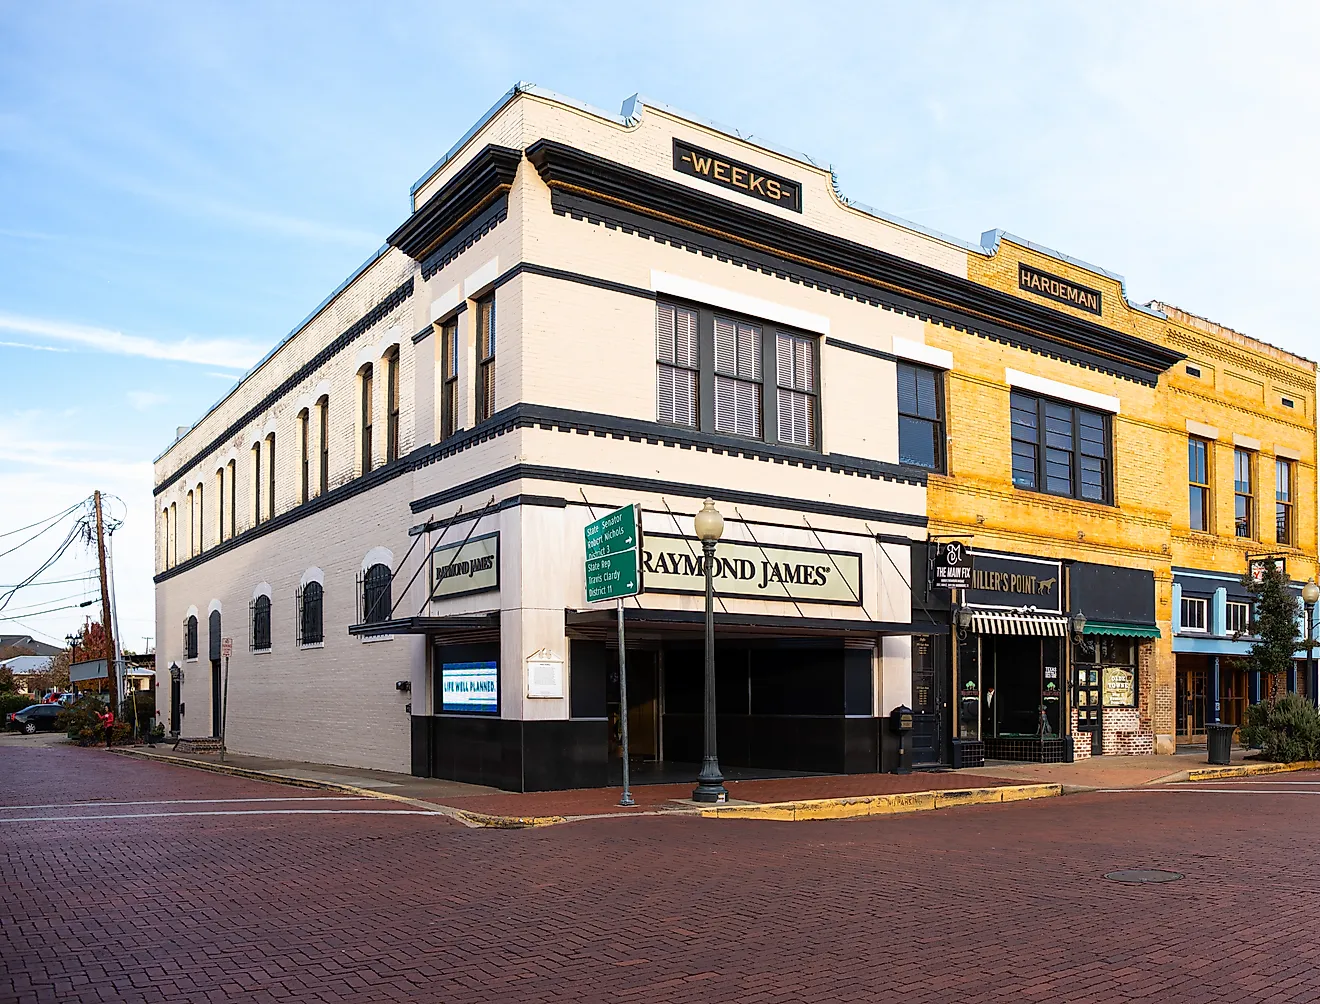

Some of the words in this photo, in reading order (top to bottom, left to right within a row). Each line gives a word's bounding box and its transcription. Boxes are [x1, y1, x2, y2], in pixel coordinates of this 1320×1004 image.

[1021, 270, 1097, 309] HARDEMAN
[587, 525, 599, 536] State
[601, 514, 622, 529] Senator
[587, 536, 604, 549] Robert
[604, 526, 625, 541] Nichols
[588, 547, 606, 560] District
[606, 545, 611, 553] 3
[436, 560, 470, 580] RAYMOND
[587, 563, 600, 572] State
[601, 560, 611, 570] Rep
[643, 551, 755, 580] RAYMOND
[936, 566, 947, 578] THE
[947, 566, 961, 579] MAIN
[961, 567, 971, 578] FIX
[588, 575, 602, 585] Travis
[603, 570, 621, 581] Clardy
[1011, 574, 1037, 595] POINT
[588, 587, 606, 597] District
[606, 585, 613, 593] 11
[444, 681, 454, 692] LIFE
[455, 681, 469, 692] WELL
